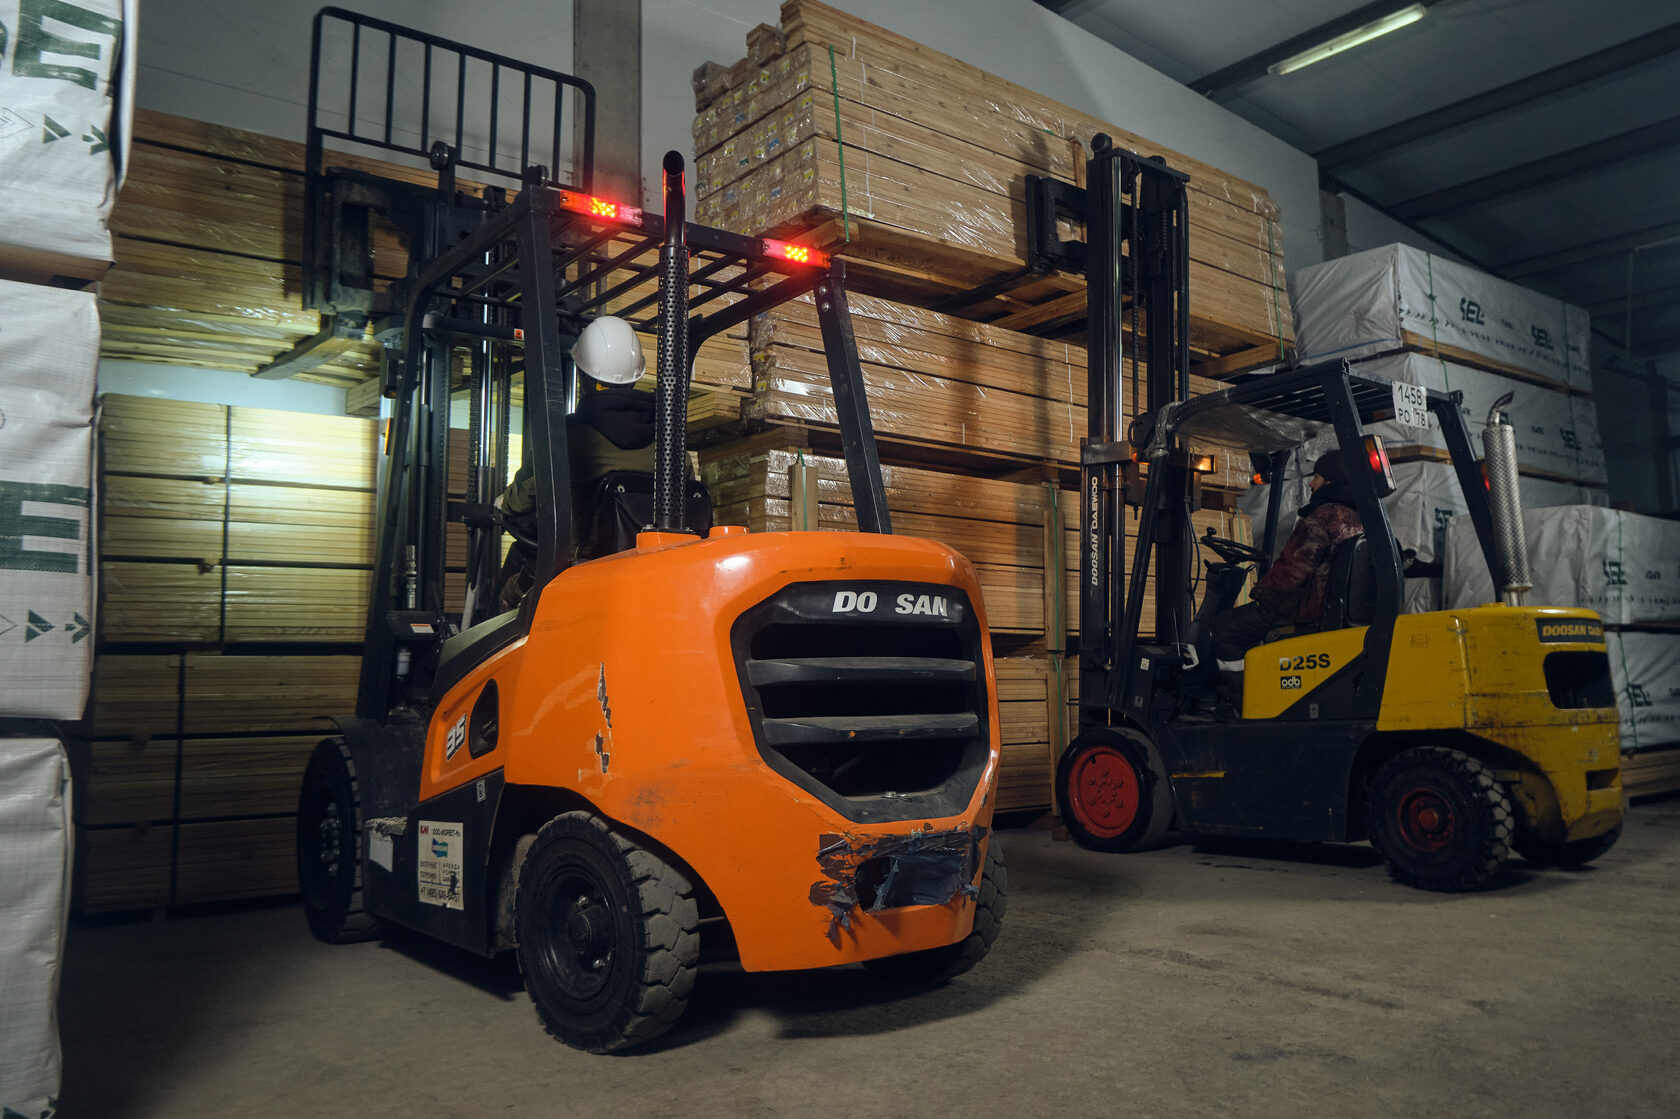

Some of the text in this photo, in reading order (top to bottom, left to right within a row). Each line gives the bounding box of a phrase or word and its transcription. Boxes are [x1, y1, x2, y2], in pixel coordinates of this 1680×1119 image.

[1398, 384, 1423, 405] 1458
[1415, 412, 1427, 427] 78
[1091, 476, 1099, 587] DOOSAN DAEWOO
[1542, 624, 1587, 637] DOOSAN
[1279, 653, 1331, 671] D25S
[446, 713, 467, 761] 35
